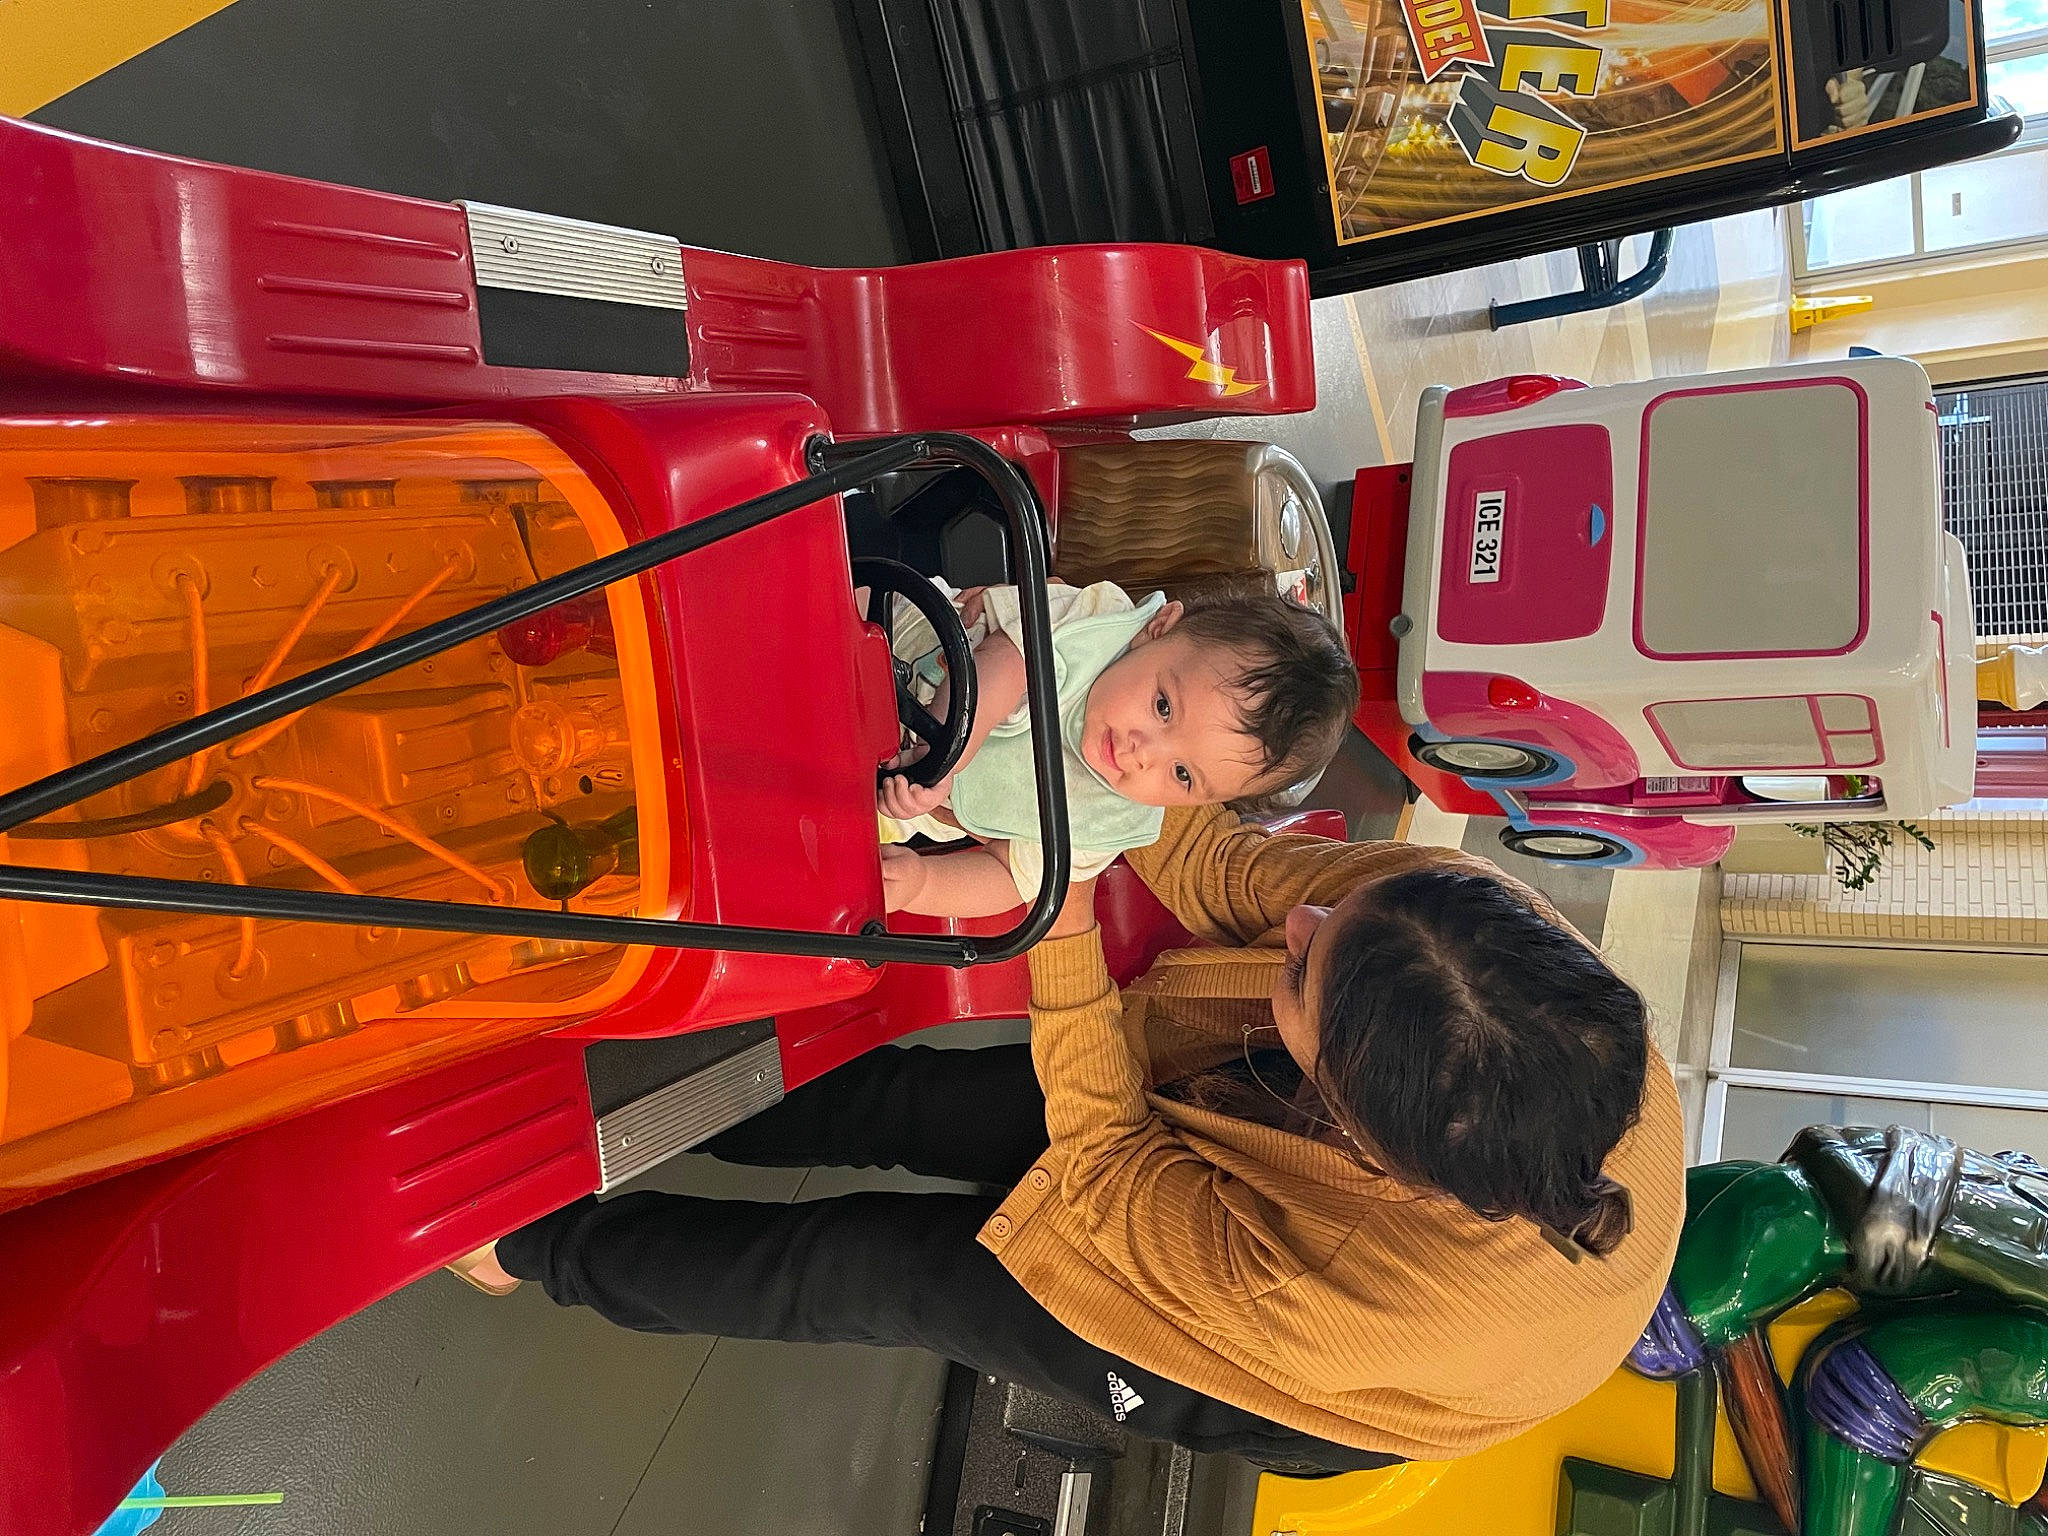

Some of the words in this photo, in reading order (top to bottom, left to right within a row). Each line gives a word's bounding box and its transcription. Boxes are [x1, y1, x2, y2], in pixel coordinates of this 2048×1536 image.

[1477, 498, 1502, 533] ICE
[1473, 538, 1498, 575] 321
[1106, 1371, 1127, 1422] adidas
